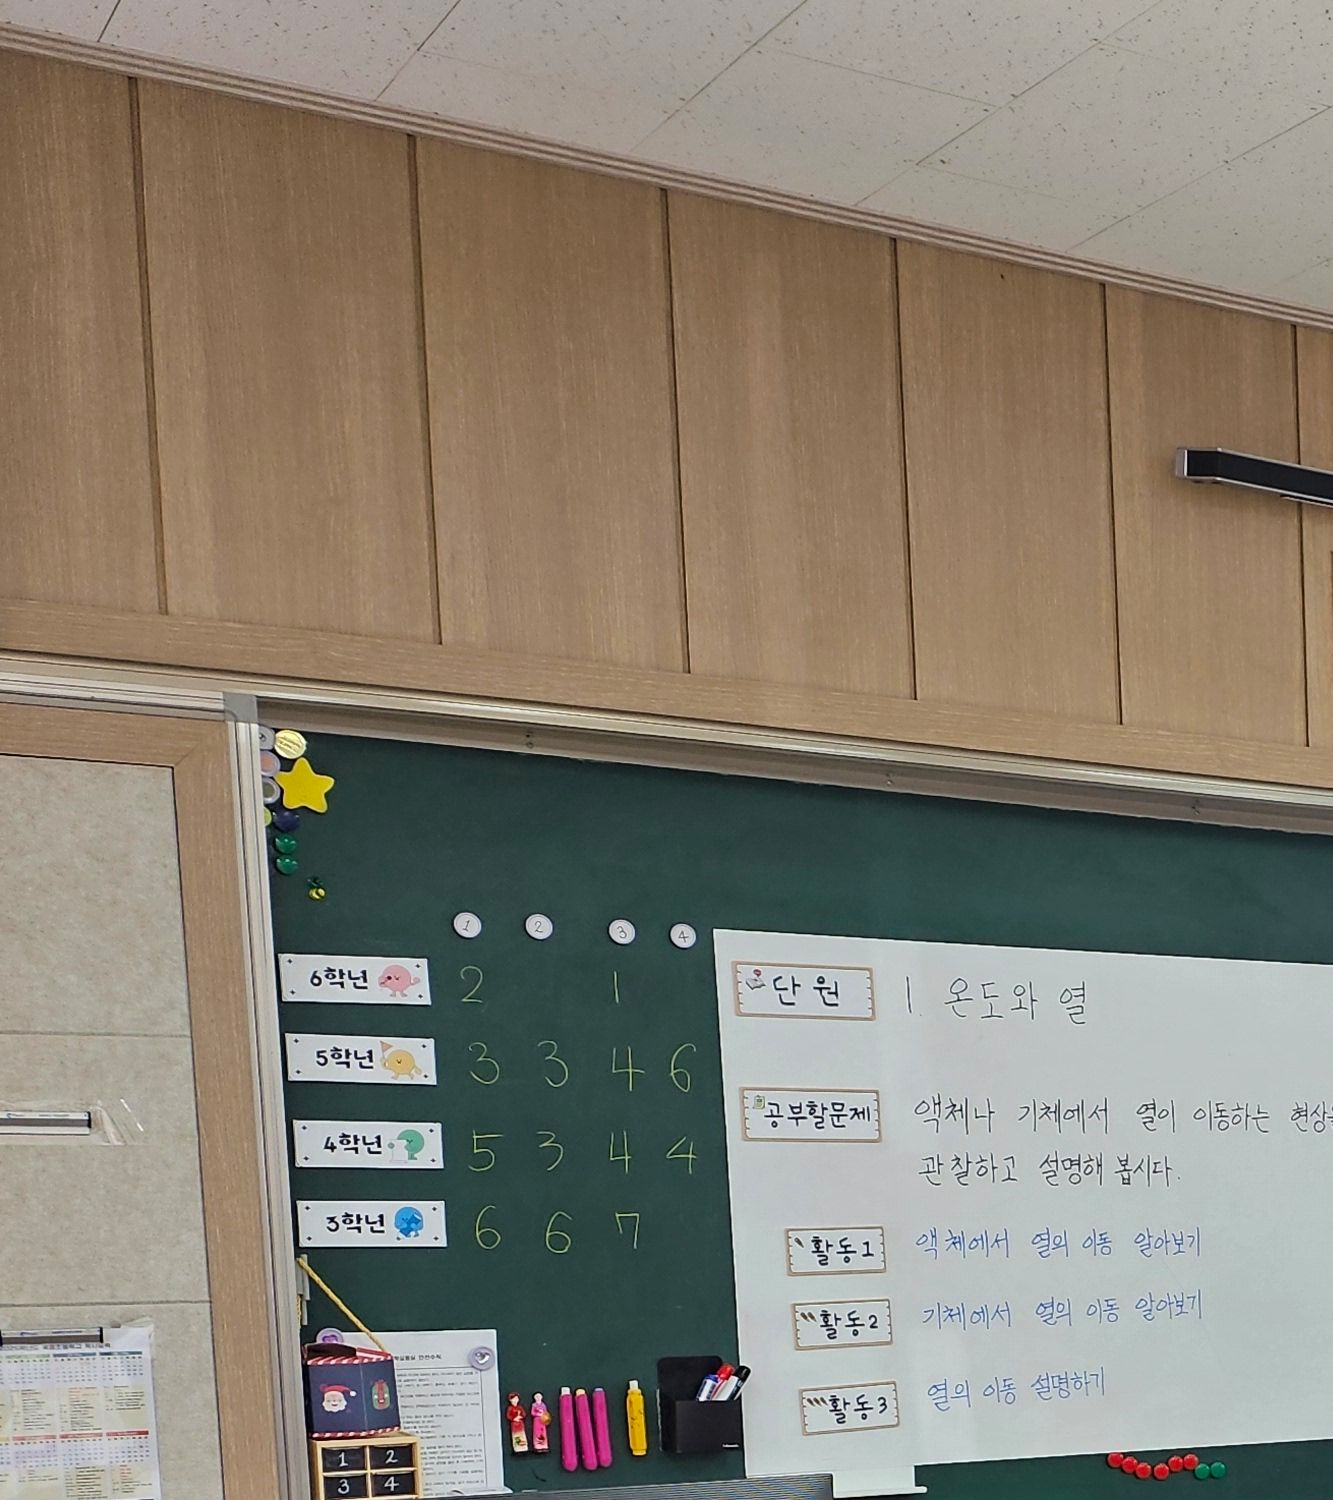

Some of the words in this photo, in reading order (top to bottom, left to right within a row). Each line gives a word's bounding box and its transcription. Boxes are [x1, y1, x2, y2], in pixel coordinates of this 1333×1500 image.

[309, 967, 369, 990] 6학년
[459, 966, 484, 1003] 2
[613, 970, 620, 1004] 1
[944, 977, 1038, 1020] 온도와
[1059, 980, 1089, 1025] 열
[315, 1047, 375, 1069] 5학년
[469, 1042, 500, 1085] 3
[537, 1040, 569, 1088] 3
[612, 1045, 645, 1092] 4
[669, 1043, 697, 1093] 6
[763, 1100, 872, 1129] 공부할문제
[914, 1092, 995, 1134] 액체나
[1018, 1097, 1108, 1135] 기체에서
[1136, 1098, 1176, 1133] 열이
[1193, 1100, 1270, 1133] 이동하는
[323, 1134, 383, 1156] 4학년
[468, 1129, 503, 1172] 5
[536, 1131, 565, 1172] 3
[609, 1130, 632, 1175] 4
[666, 1136, 697, 1175] 4
[917, 1152, 1018, 1187] 관찰하고
[1038, 1151, 1103, 1186] 설명해
[1114, 1152, 1182, 1187] 봅시다.
[326, 1213, 385, 1234] 3학년
[475, 1205, 501, 1250] 6
[545, 1211, 572, 1254] 6
[615, 1213, 640, 1250] 7
[811, 1237, 875, 1266] 활동1
[916, 1228, 1010, 1260] 액체에서
[1031, 1228, 1069, 1259] 열의
[1082, 1229, 1113, 1257] 이동
[1134, 1226, 1201, 1258] 알아보기
[819, 1310, 879, 1340] 활동2
[922, 1301, 1011, 1332] 기체에서
[1034, 1298, 1073, 1327] 열의
[1086, 1297, 1120, 1324] 이동
[1134, 1289, 1202, 1321] 알아보기
[927, 1379, 971, 1413] 열의
[983, 1376, 1017, 1406] 이동
[1030, 1367, 1105, 1401] 설명하기
[828, 1394, 888, 1425] 활동3
[338, 1450, 349, 1467] 1
[385, 1450, 399, 1465] 2
[338, 1478, 350, 1495] 3
[384, 1476, 400, 1492] 4
